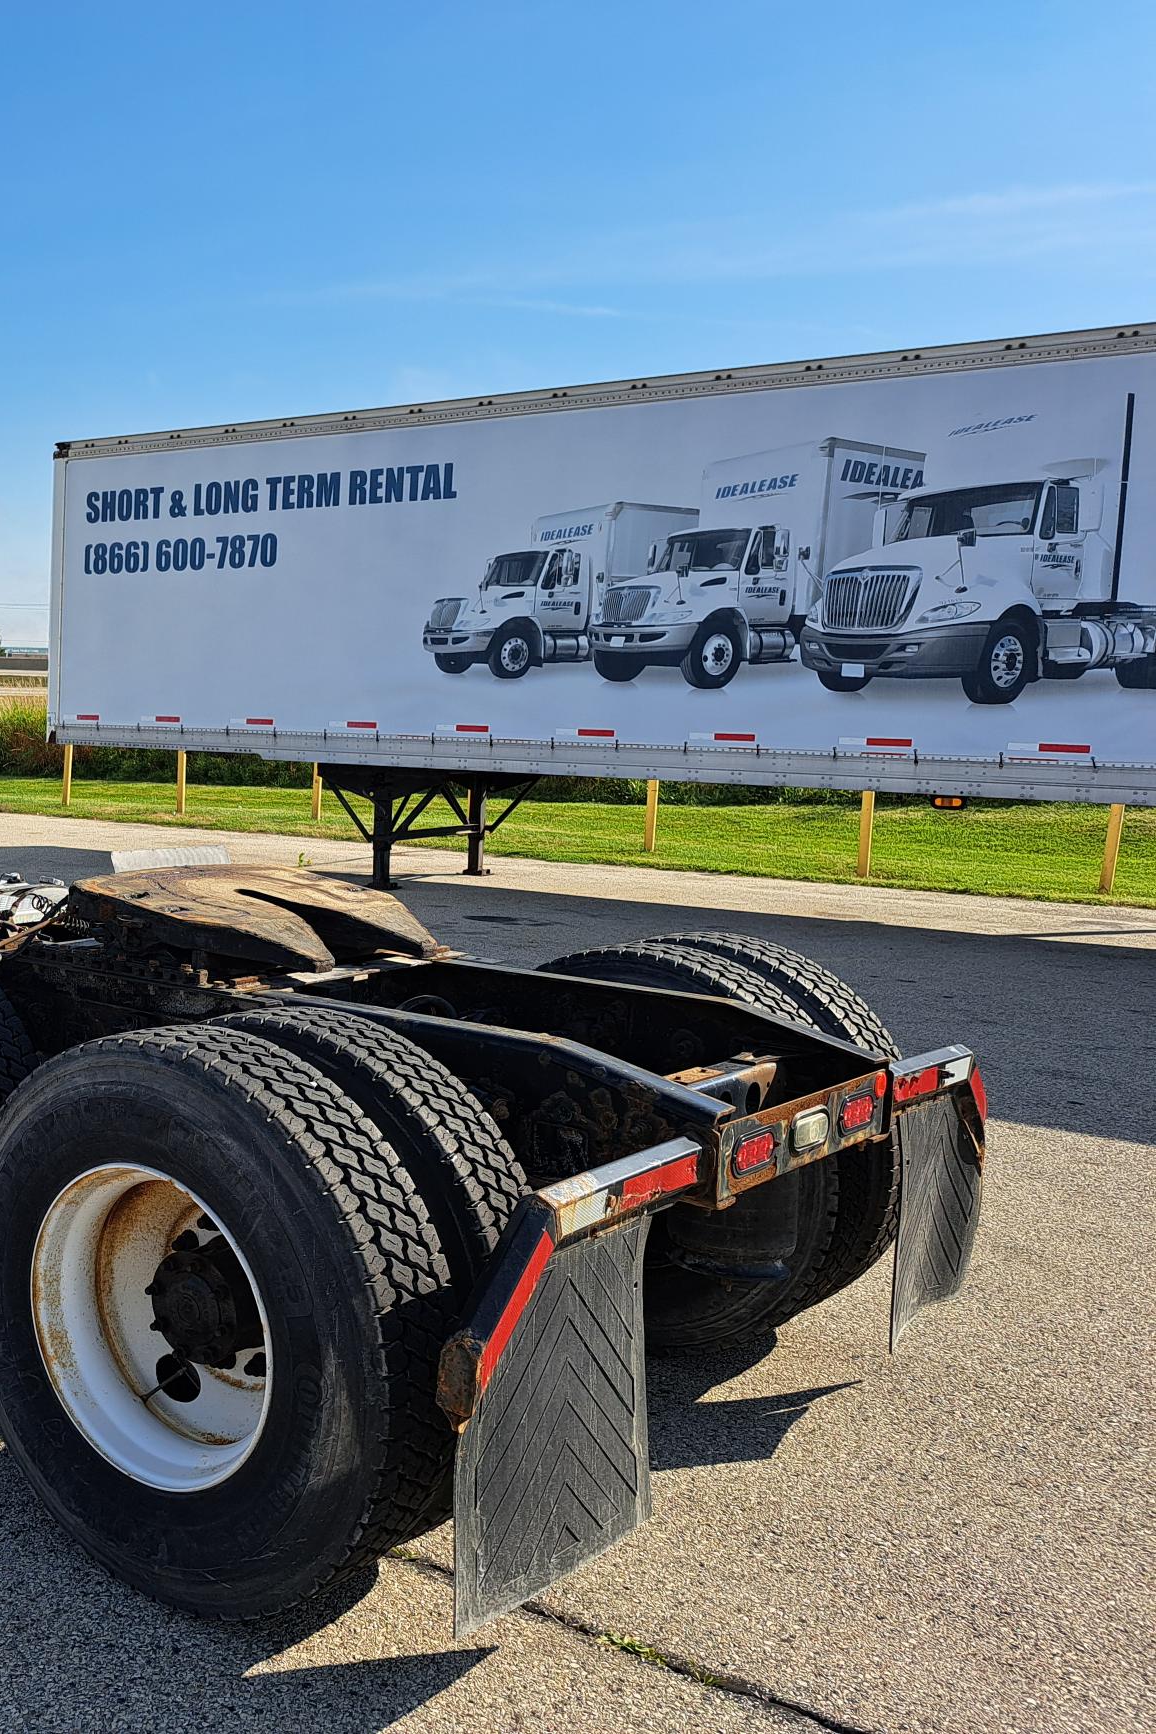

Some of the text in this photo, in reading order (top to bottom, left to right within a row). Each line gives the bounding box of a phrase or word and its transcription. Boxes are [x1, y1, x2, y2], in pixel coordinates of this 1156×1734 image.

[85, 462, 458, 524] SHORT & LONG TERM RENTAL
[715, 473, 800, 500] IDEALEASE
[540, 523, 594, 542] IDEALEASE
[84, 533, 278, 575] (866) 600-7870
